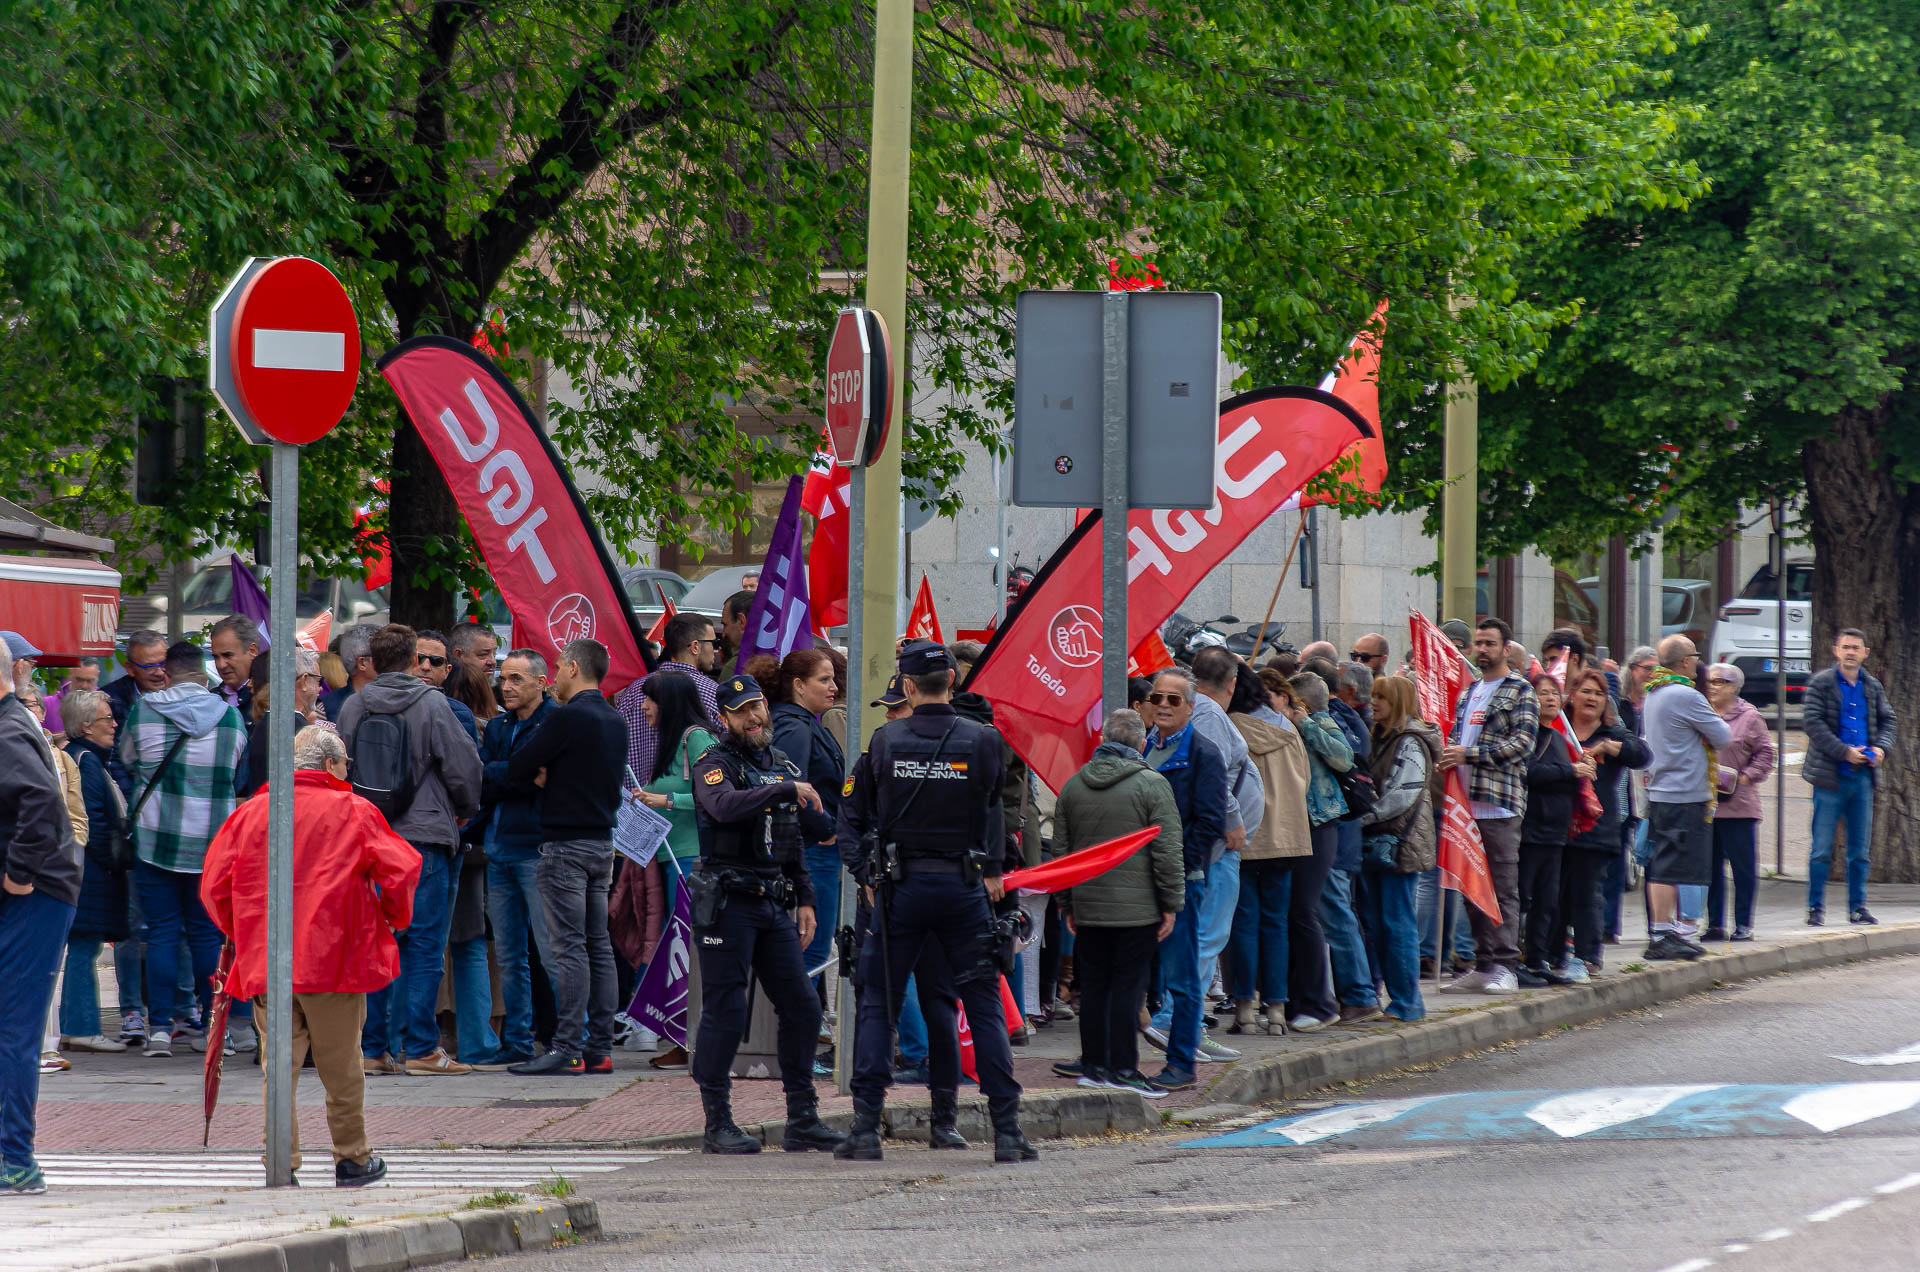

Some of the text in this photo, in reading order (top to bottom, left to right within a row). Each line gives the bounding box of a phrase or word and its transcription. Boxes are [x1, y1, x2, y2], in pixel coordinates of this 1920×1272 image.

[830, 369, 861, 405] STOP
[1024, 653, 1068, 697] Toledo
[703, 936, 723, 946] CNP
